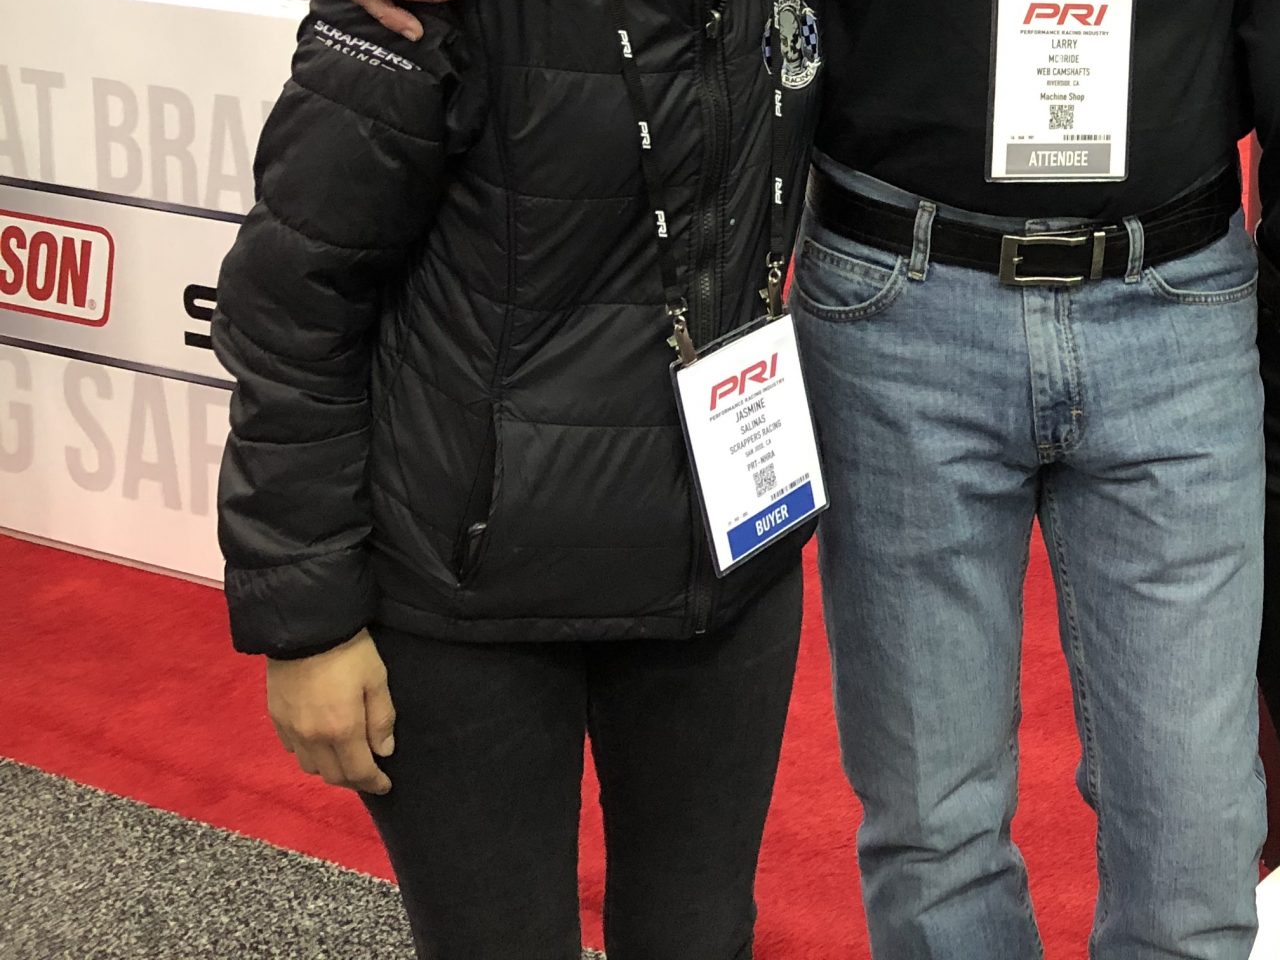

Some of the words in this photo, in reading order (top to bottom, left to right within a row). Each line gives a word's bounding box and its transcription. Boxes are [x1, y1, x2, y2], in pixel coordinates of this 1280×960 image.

[1023, 3, 1108, 26] PRI
[314, 20, 413, 70] SCRAPPERS
[324, 39, 381, 67] RACING
[618, 30, 632, 58] PRI
[1051, 39, 1078, 49] LARRY
[1036, 68, 1051, 76] WEB
[1052, 68, 1090, 76] CAMSHAFTS
[1040, 92, 1067, 101] Machine
[1069, 92, 1085, 102] Shop
[91, 76, 281, 216] BRA
[638, 121, 651, 149] PRI
[1029, 151, 1089, 168] ATTENDEE
[655, 210, 668, 238] PRI
[709, 352, 778, 412] PRI
[735, 397, 766, 423] JASMINE
[729, 431, 761, 455] SCRAPPERS
[761, 419, 782, 436] RACING
[740, 414, 766, 435] SALINAS
[755, 503, 789, 536] BUYER
